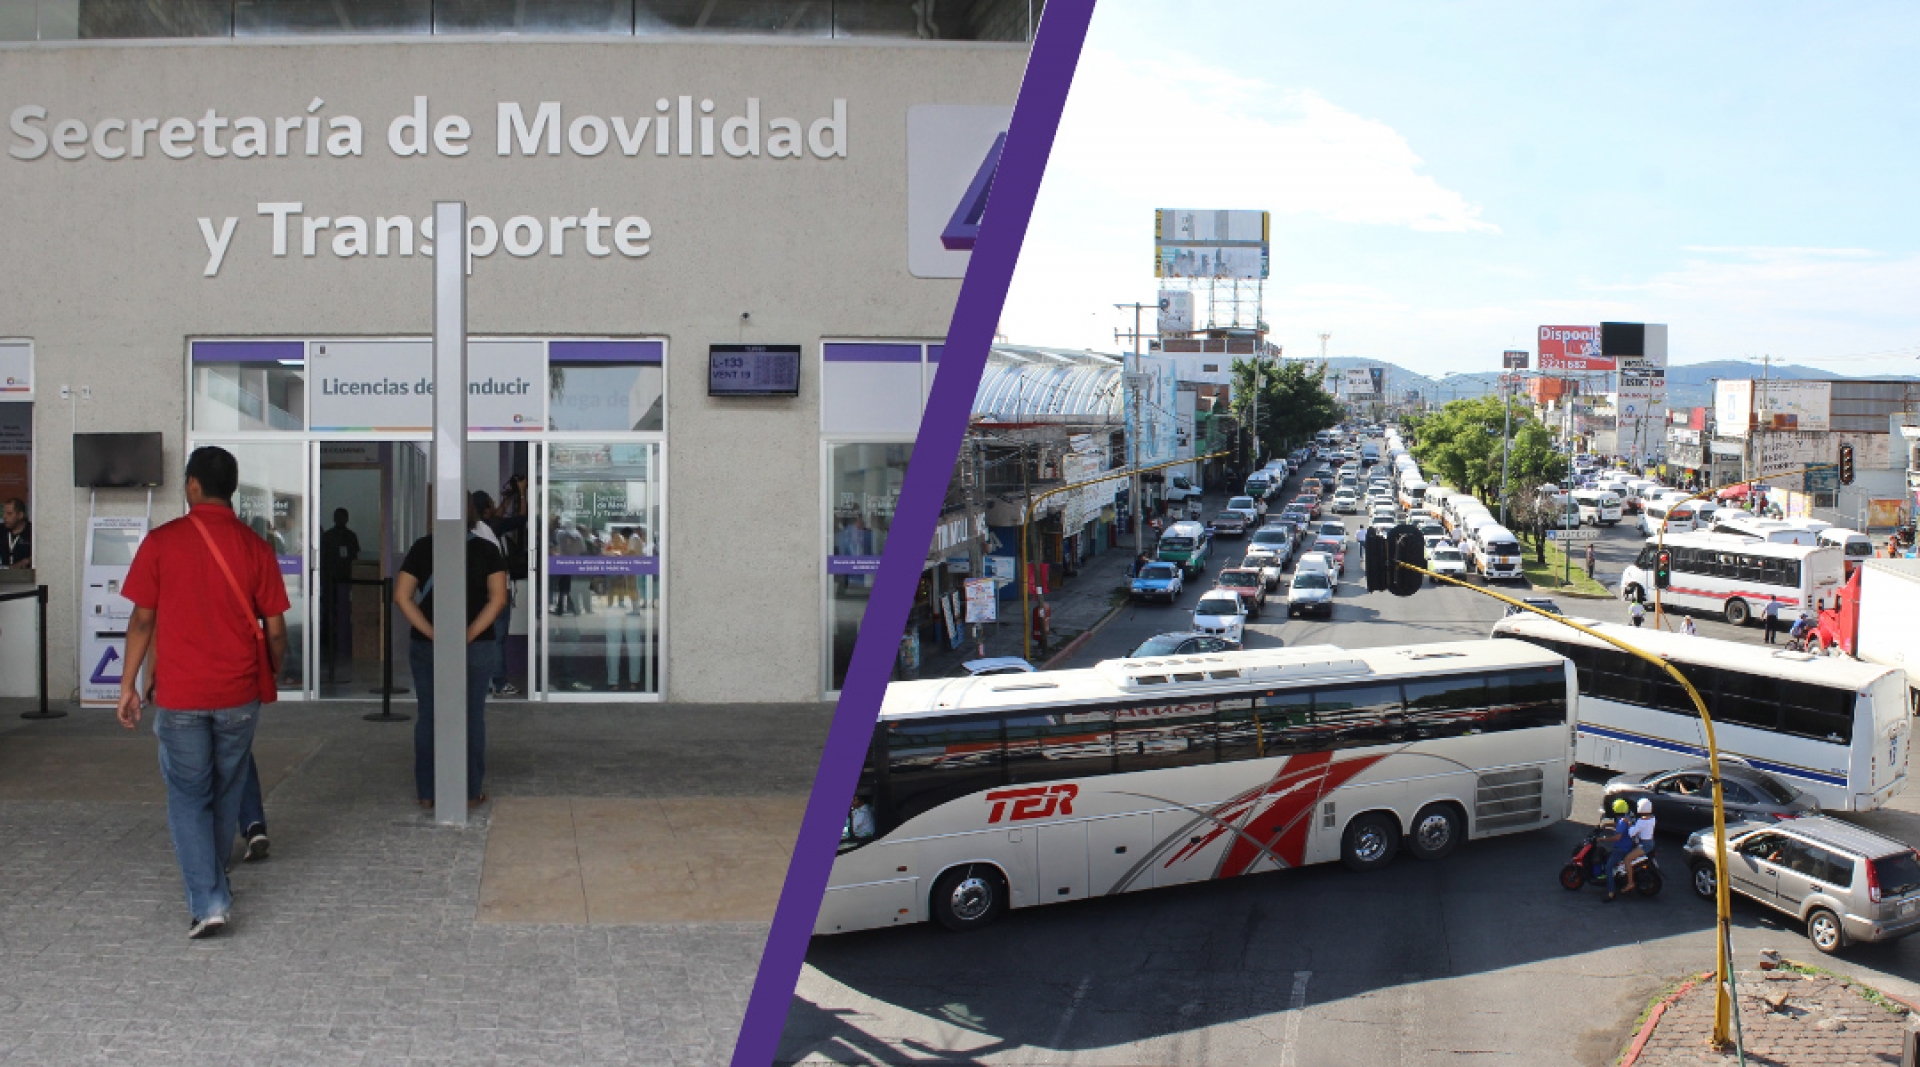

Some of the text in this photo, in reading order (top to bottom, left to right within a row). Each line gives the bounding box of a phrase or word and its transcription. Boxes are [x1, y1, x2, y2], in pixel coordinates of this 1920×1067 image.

[8, 95, 849, 160] Secretaría de Movilidad
[197, 215, 240, 277] y
[322, 377, 530, 396] Licencias de nducir
[985, 783, 1079, 824] TER
